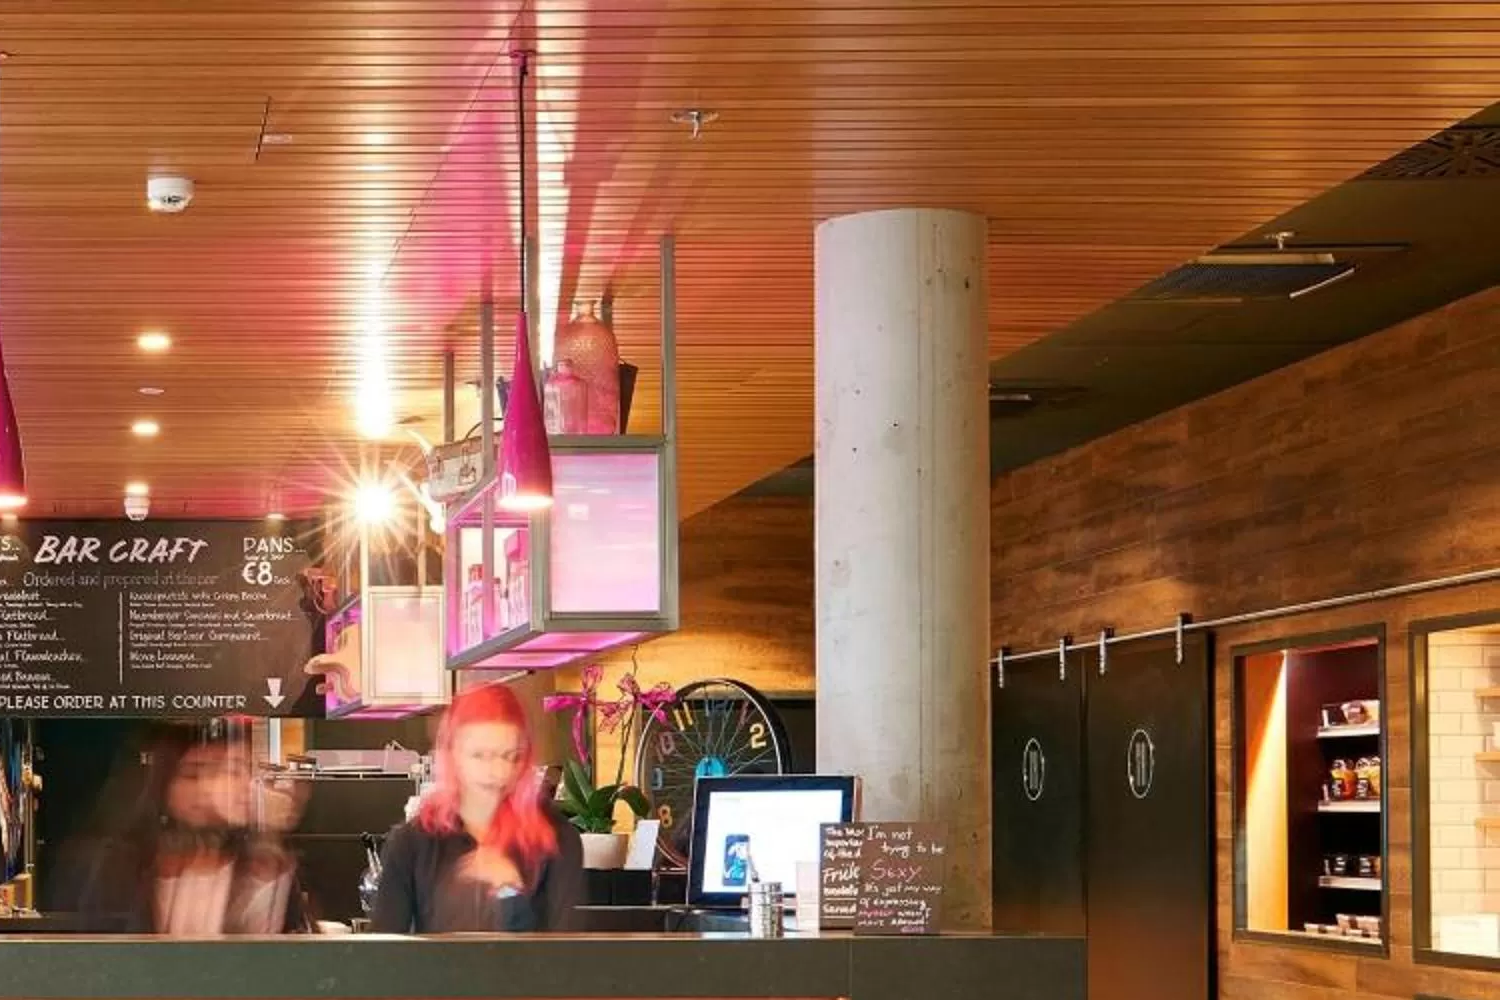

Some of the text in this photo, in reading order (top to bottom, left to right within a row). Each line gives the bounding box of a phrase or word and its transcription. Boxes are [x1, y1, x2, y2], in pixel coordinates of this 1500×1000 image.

[34, 535, 208, 564] BAR CRAFT
[23, 571, 75, 587] Ordered
[78, 572, 100, 586] and
[242, 562, 273, 586] €8
[53, 696, 104, 709] ORDER
[109, 696, 127, 709] AT
[132, 696, 165, 709] THIS
[173, 696, 247, 709] COUNTER
[749, 722, 767, 749] 2
[659, 804, 674, 828] 8
[867, 825, 913, 840] I'm not
[916, 842, 927, 853] to
